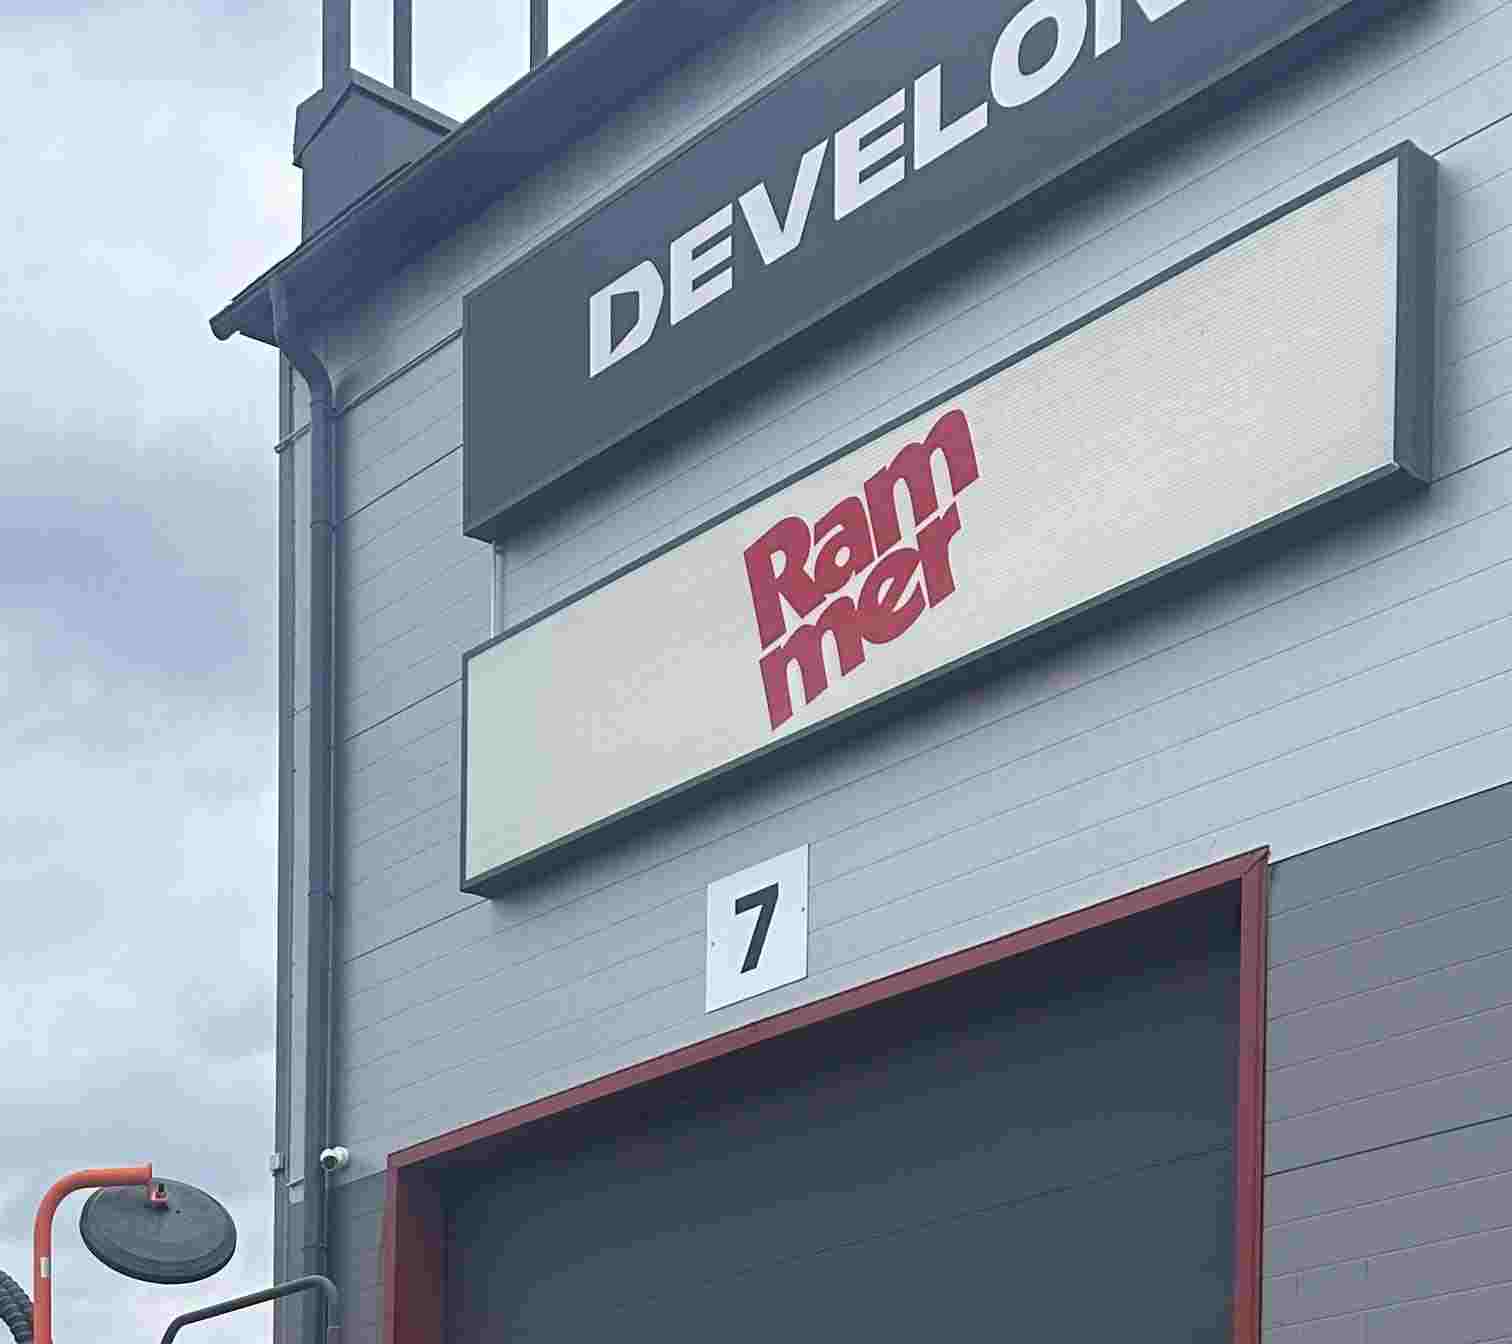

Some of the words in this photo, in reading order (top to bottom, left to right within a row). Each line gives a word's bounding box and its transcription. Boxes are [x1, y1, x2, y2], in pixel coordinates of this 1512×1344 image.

[743, 408, 980, 650] Ram
[758, 501, 962, 732] mer
[734, 881, 780, 975] 7
